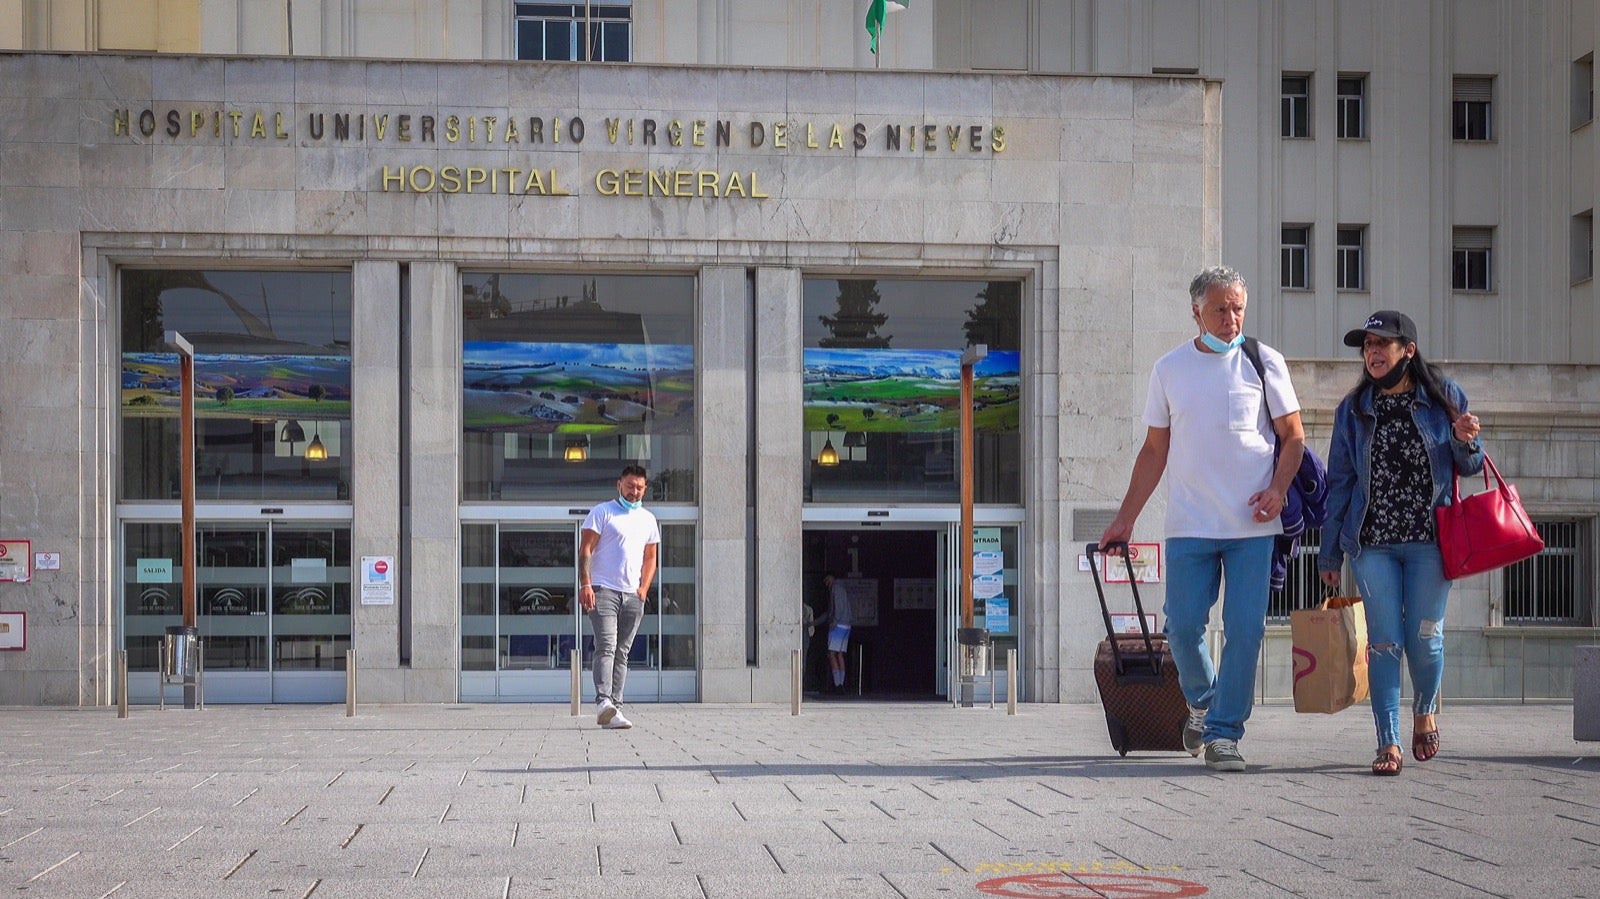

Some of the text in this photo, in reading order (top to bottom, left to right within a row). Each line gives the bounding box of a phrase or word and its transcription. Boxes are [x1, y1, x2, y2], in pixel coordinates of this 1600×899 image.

[113, 107, 1007, 154] HOSPITAL UNIVERSITARIO VIRGEN DE LAS NIEVES
[382, 165, 769, 199] HOSPITAL GENERAL
